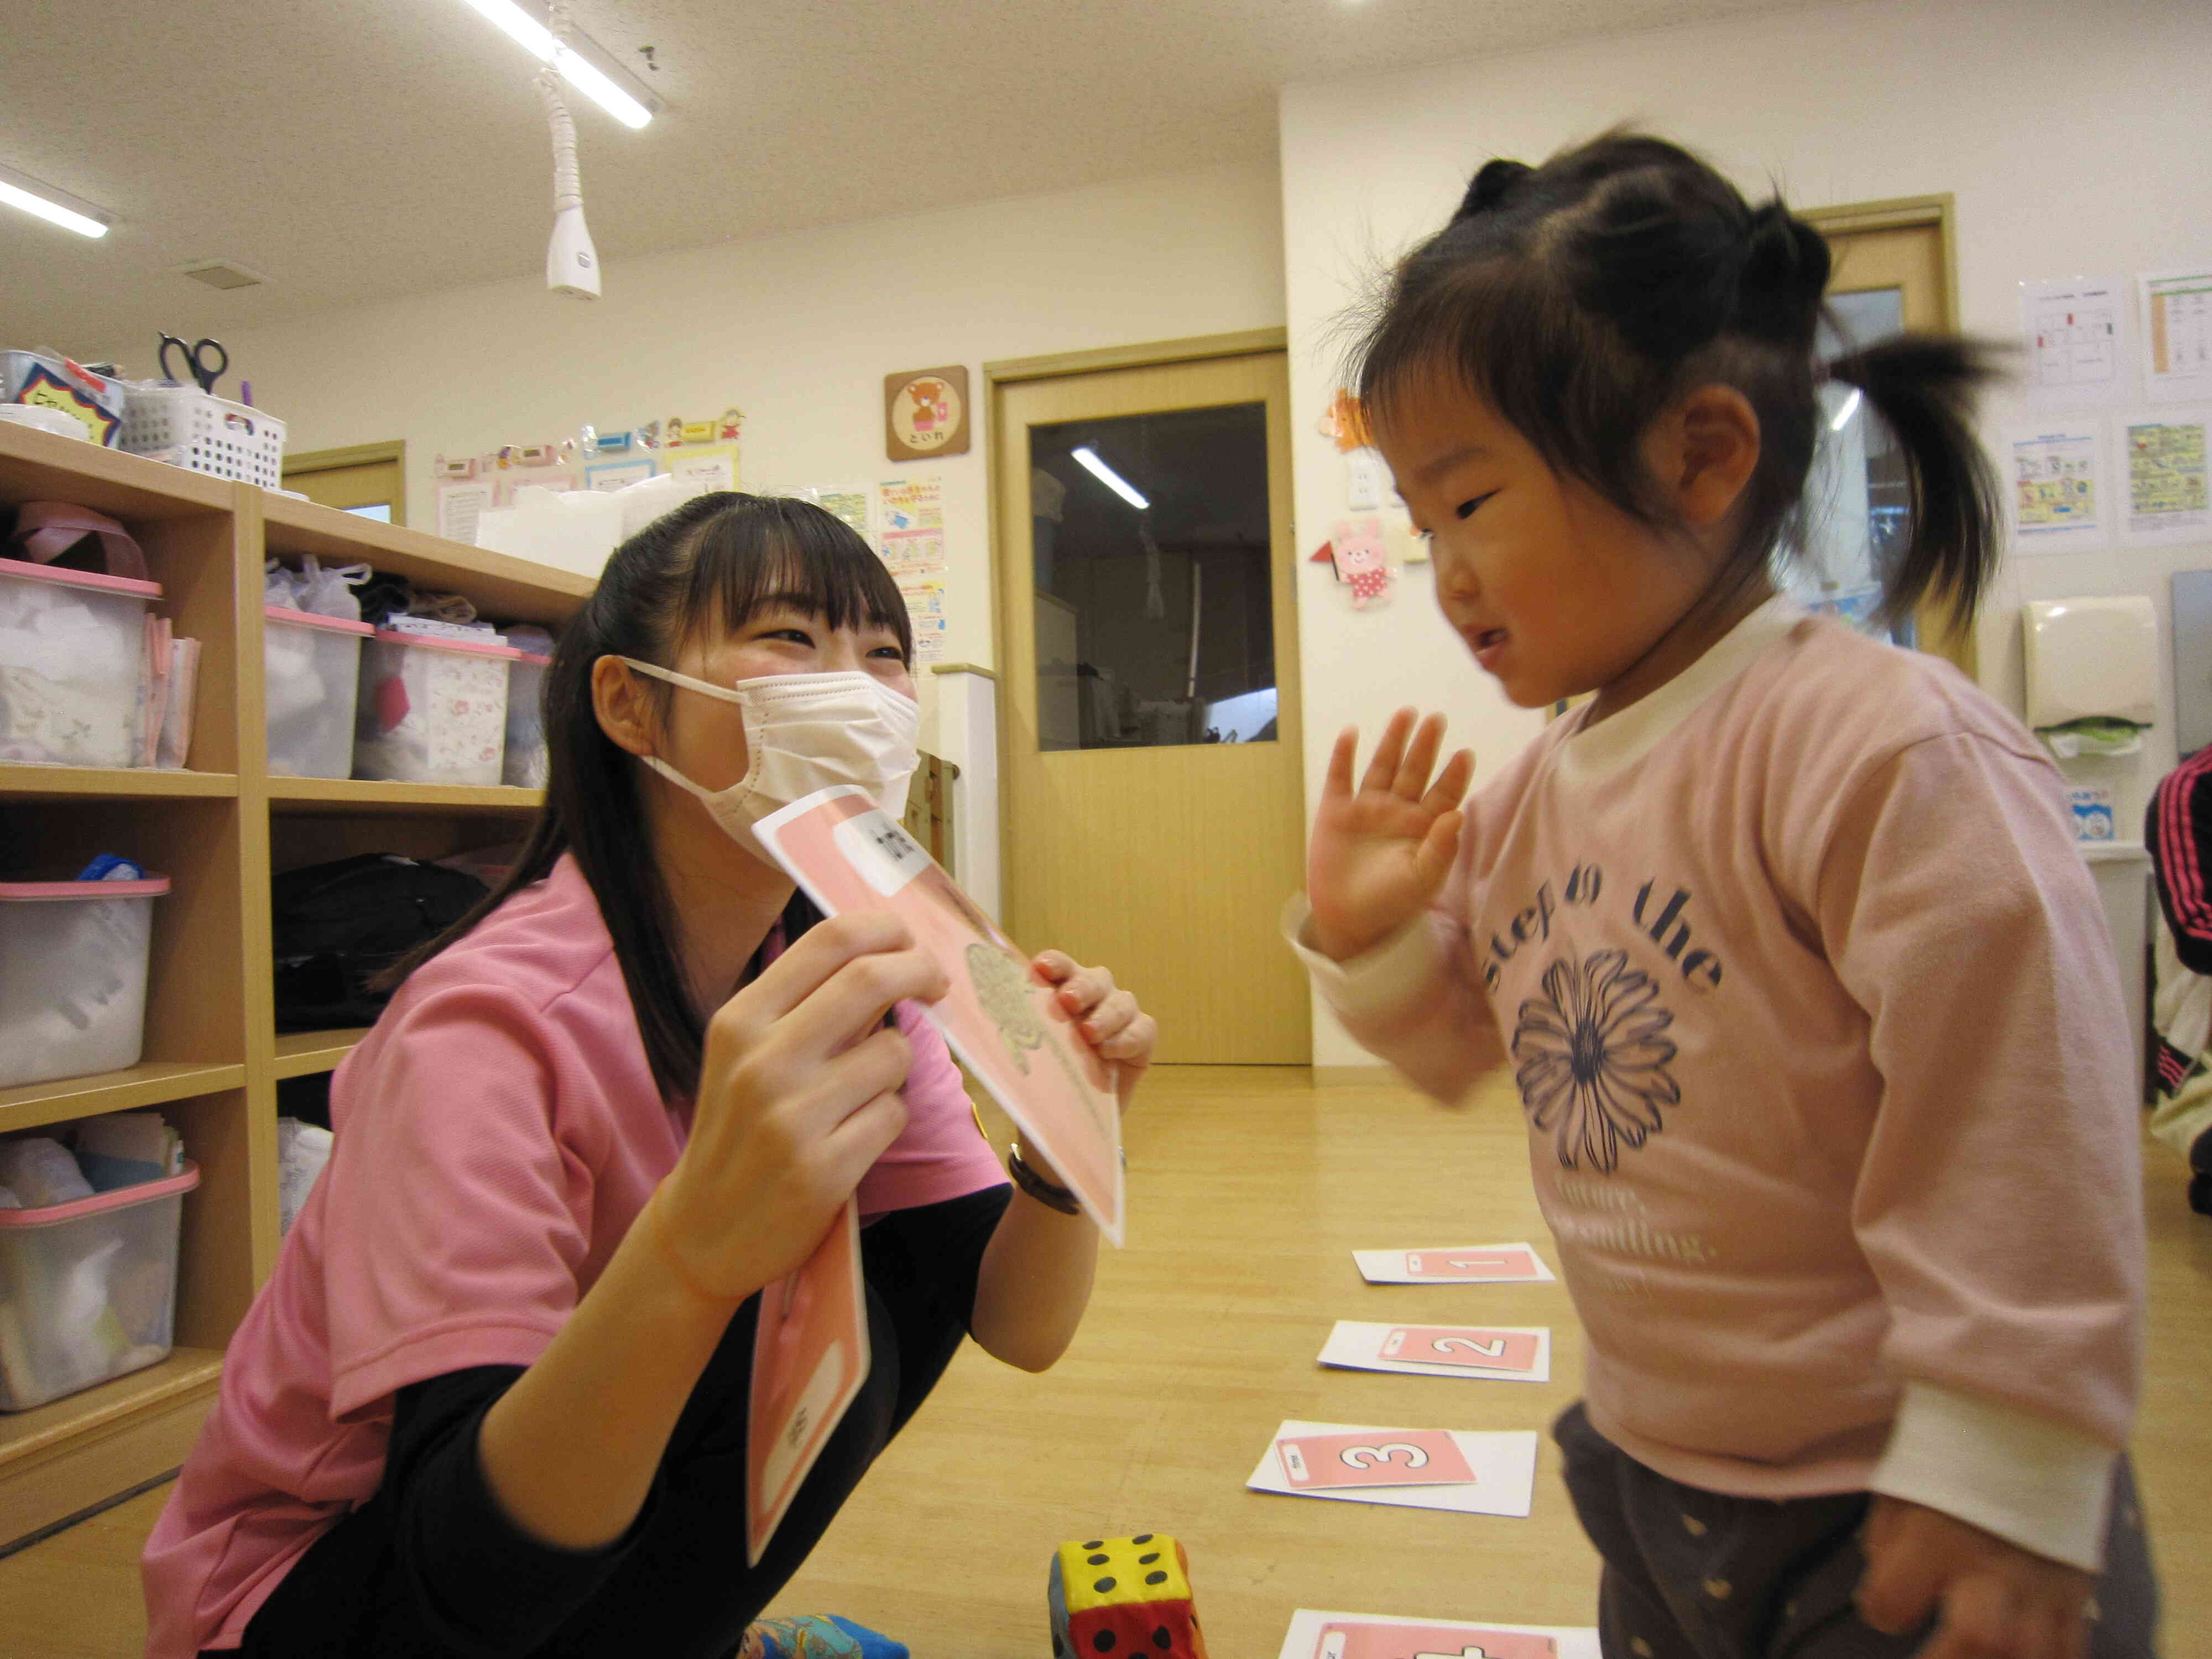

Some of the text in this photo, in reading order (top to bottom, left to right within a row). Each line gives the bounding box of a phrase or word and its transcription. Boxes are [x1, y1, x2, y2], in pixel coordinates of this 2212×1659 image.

[910, 431, 943, 443] といれ
[1632, 875, 1722, 993] the
[1447, 1259, 1509, 1269] 1
[1431, 1336, 1507, 1358] 2
[1339, 1442, 1430, 1469] 3
